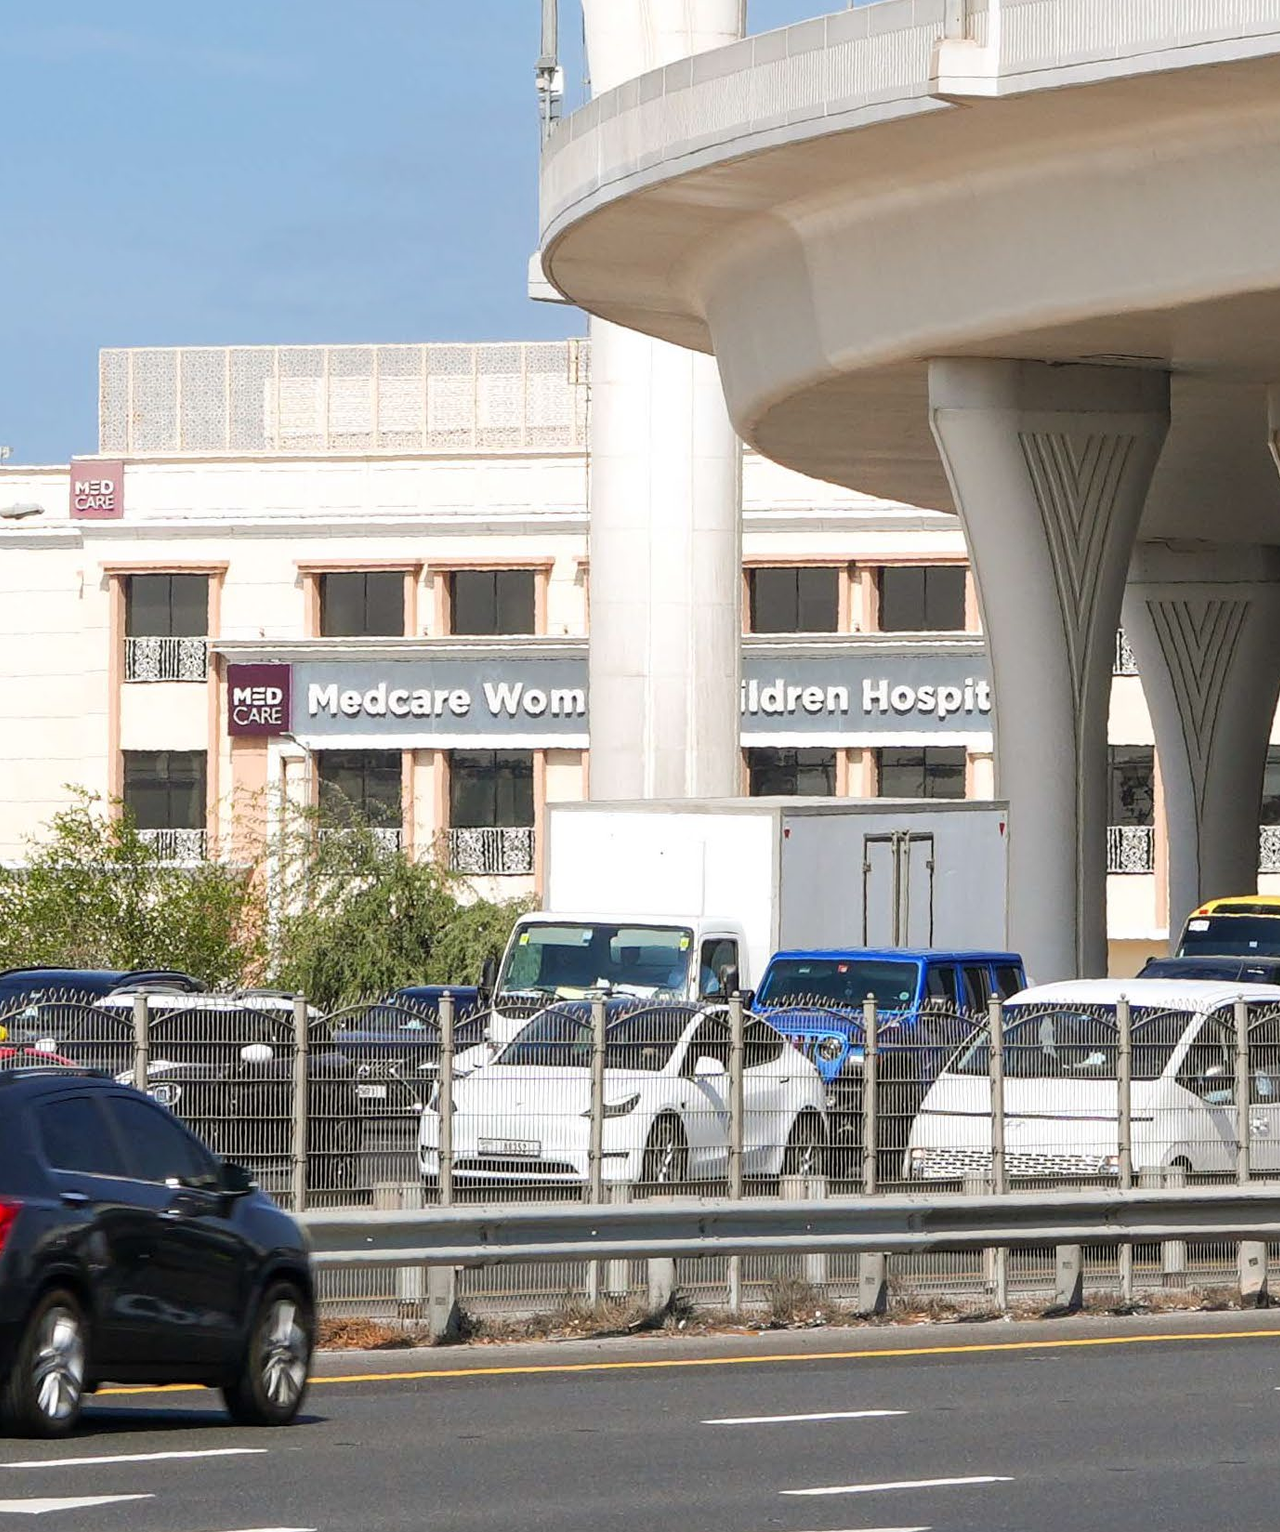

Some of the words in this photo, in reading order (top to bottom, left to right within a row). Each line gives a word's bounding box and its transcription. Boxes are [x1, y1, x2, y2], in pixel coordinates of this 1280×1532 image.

[74, 479, 115, 496] MED
[74, 495, 115, 510] CARE
[233, 686, 283, 706] MED
[307, 681, 471, 716] Medcare
[482, 681, 586, 716] Wom
[740, 678, 849, 713] ildren
[862, 677, 991, 718] Hospit
[233, 706, 282, 725] CARE
